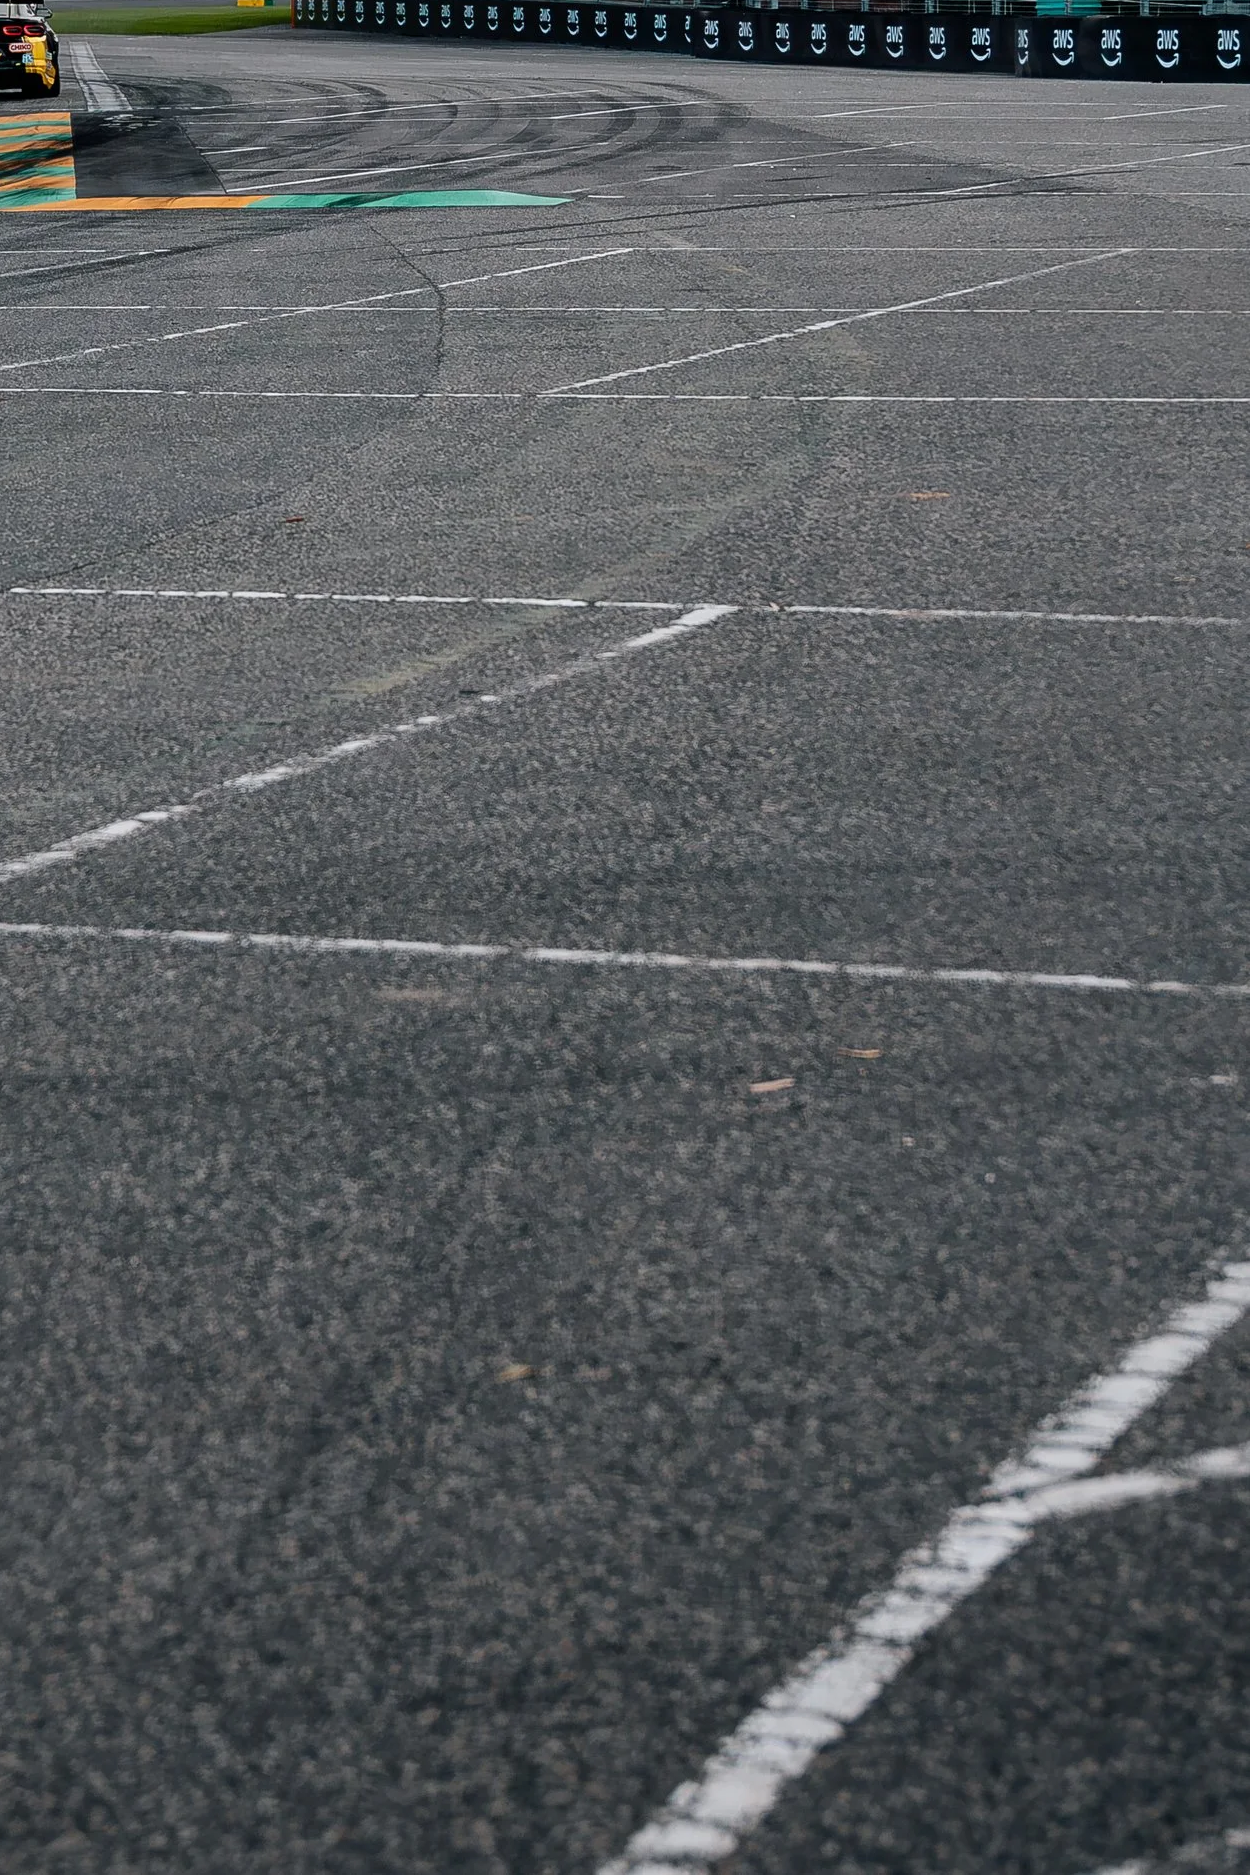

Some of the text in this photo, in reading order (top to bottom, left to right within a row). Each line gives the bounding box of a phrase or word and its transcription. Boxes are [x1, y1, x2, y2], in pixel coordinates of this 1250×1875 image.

[704, 19, 719, 36] aws
[738, 21, 753, 37] aws
[811, 23, 826, 40] aws
[849, 24, 865, 42] aws
[886, 26, 903, 43] aws
[929, 27, 945, 45] aws
[972, 27, 990, 46] aws
[1053, 29, 1074, 49] aws
[1101, 29, 1121, 49] aws
[1157, 29, 1179, 50] aws
[1217, 29, 1240, 51] aws
